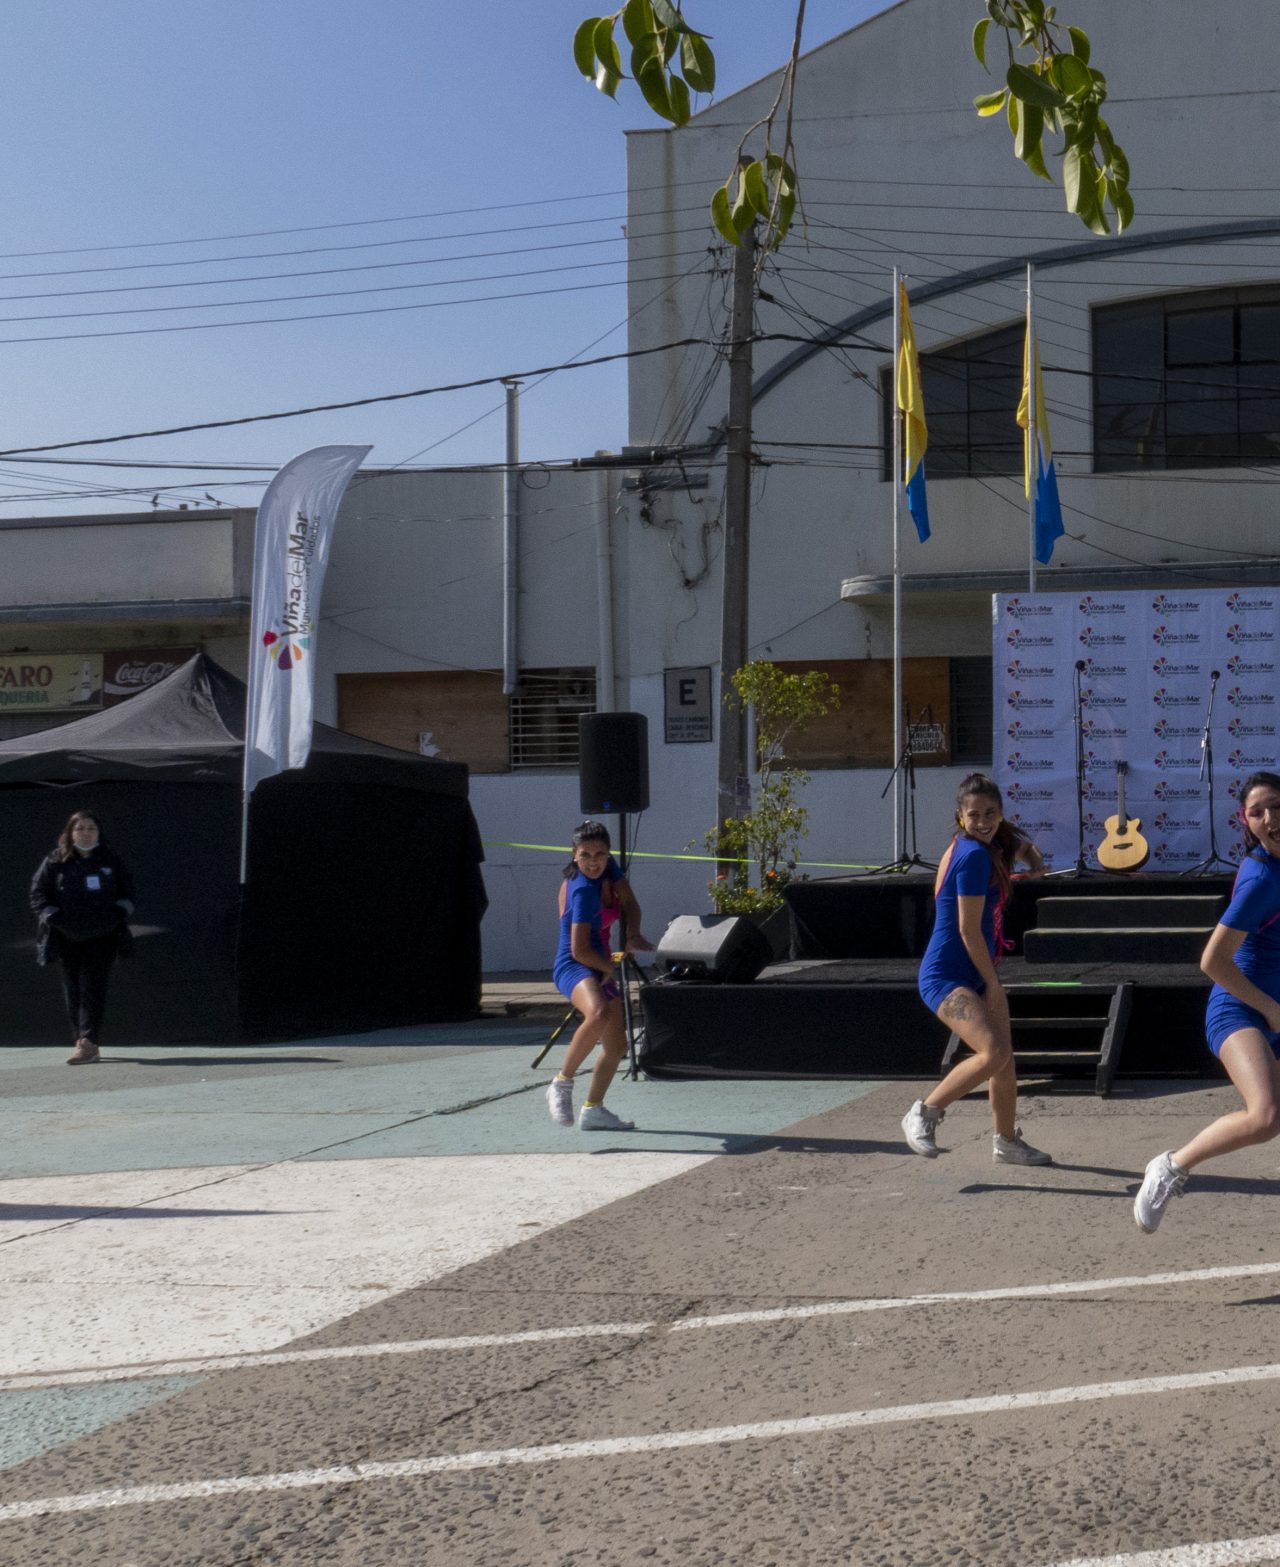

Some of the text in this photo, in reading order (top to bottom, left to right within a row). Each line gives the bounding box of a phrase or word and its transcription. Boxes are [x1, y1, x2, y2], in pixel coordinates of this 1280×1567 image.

[280, 511, 309, 637] ViñadelMar
[115, 662, 180, 684] Coca-Col
[679, 679, 697, 705] E
